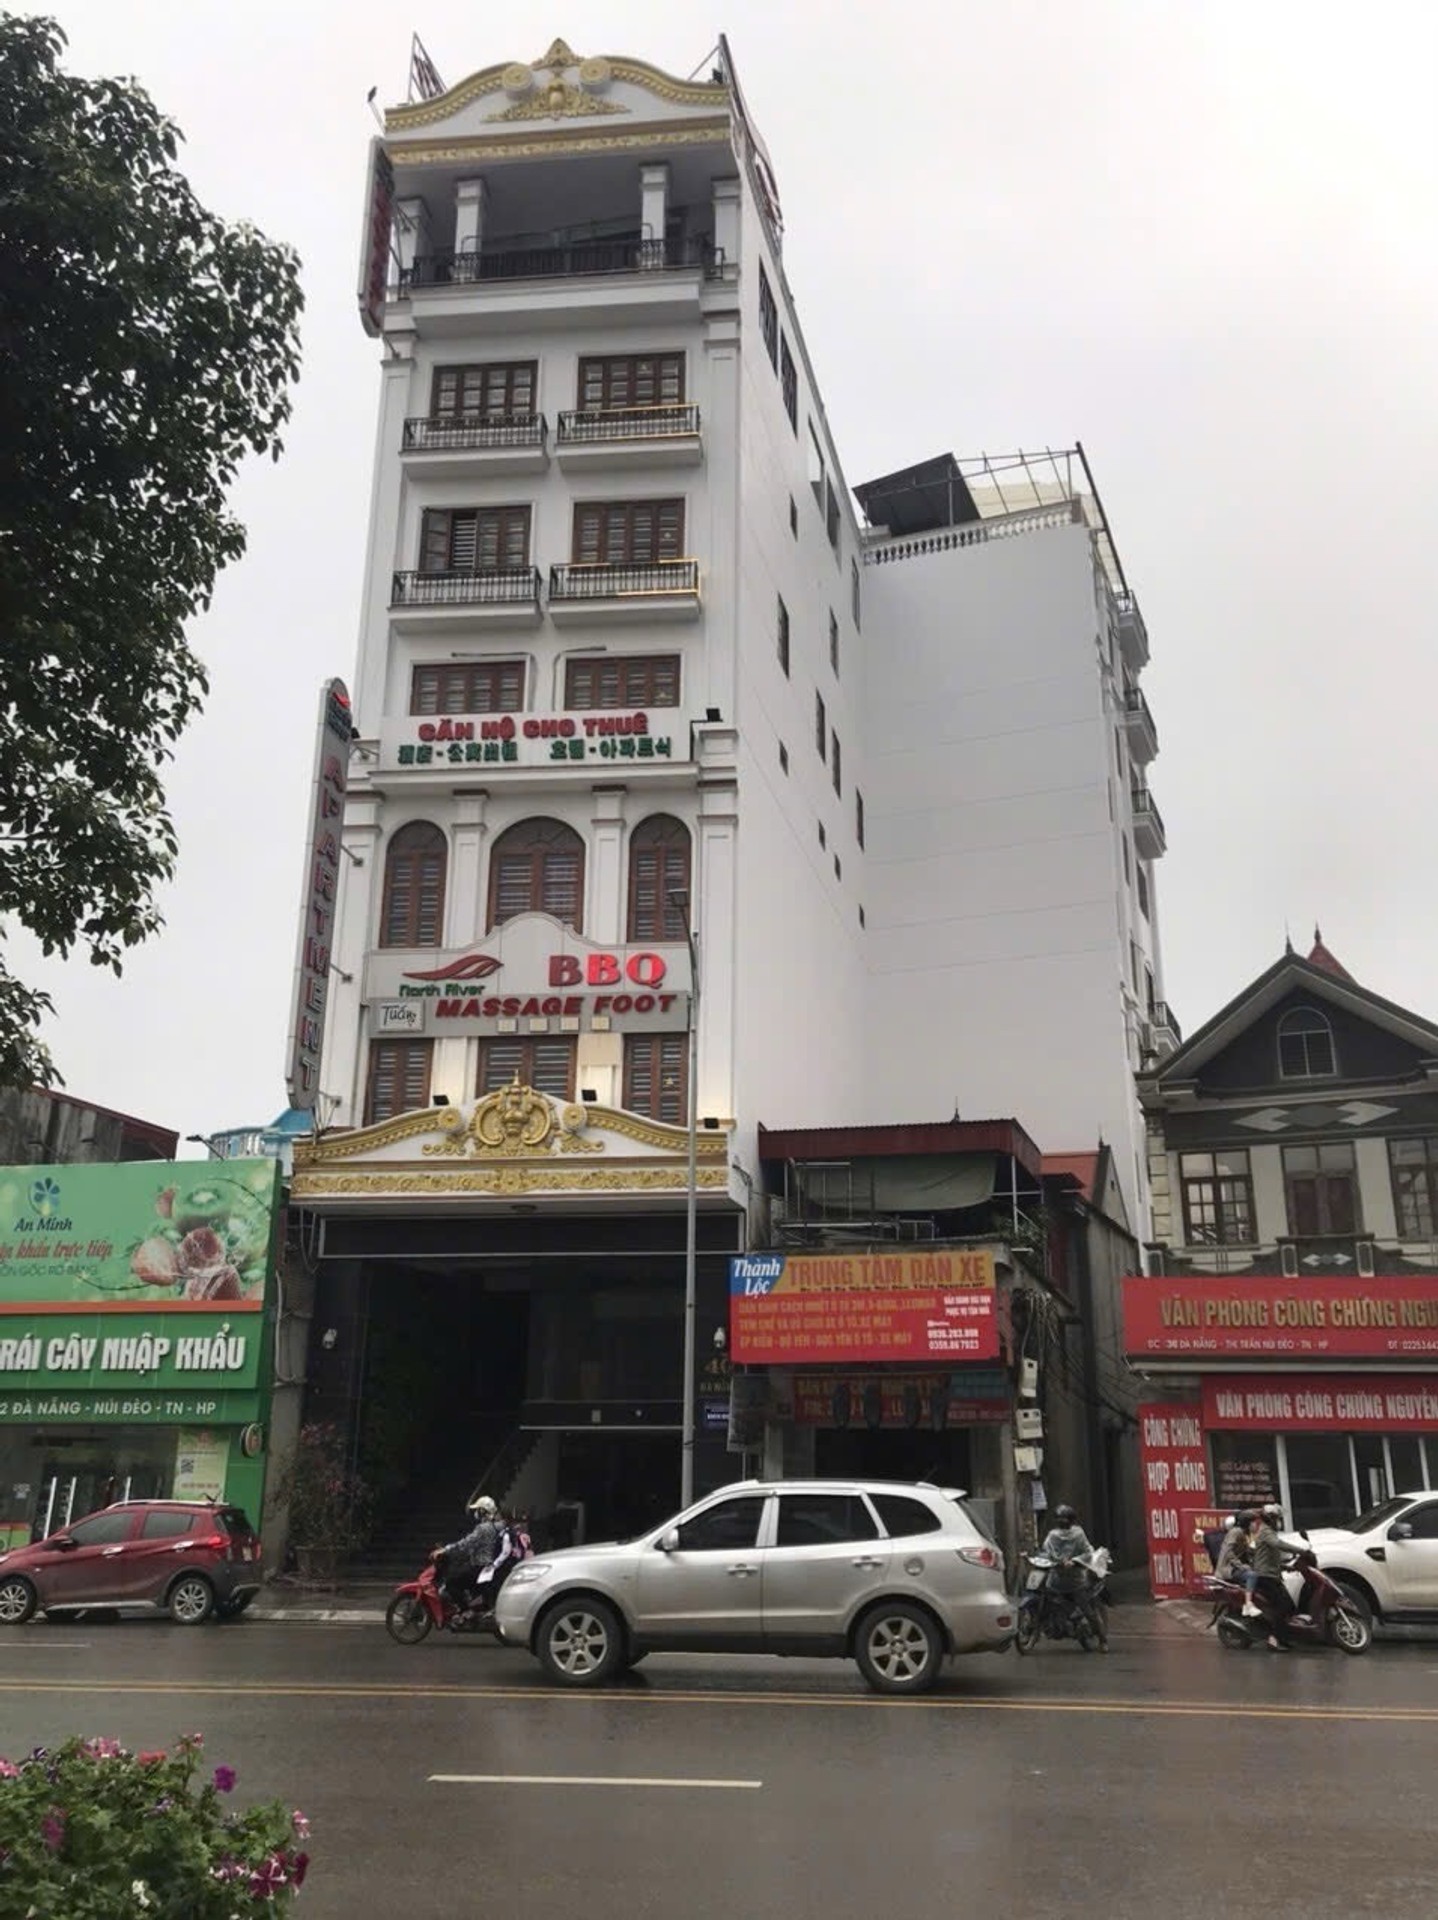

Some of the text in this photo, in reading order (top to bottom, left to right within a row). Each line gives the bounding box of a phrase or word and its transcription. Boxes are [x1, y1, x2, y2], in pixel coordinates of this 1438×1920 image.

[418, 711, 648, 744] CĂN HỘ CHO THUÊ
[301, 756, 347, 1092] APARTMENT
[549, 952, 667, 989] BBQ
[399, 984, 485, 997] North River
[435, 994, 677, 1018] MASSAGE FOOT
[14, 1218, 34, 1232] An
[734, 1258, 780, 1277] Thành
[789, 1260, 853, 1287] TRUNG
[961, 1256, 985, 1281] XE
[745, 1278, 770, 1299] Lộc
[1161, 1294, 1199, 1326] VĂN
[1205, 1293, 1269, 1327] PHÒNG
[1274, 1295, 1326, 1327] CÔNG
[1330, 1296, 1397, 1327] CHỨNG
[46, 1333, 97, 1371] CÂY
[101, 1333, 171, 1375] NHẬP
[175, 1323, 247, 1371] KHẨU
[12, 1398, 32, 1415] ĐÀ
[93, 1400, 118, 1415] NÚI
[122, 1399, 152, 1415] ĐÈO
[165, 1402, 183, 1414] TN
[196, 1402, 216, 1414] HP
[1216, 1391, 1243, 1418] VĂN
[1247, 1390, 1292, 1418] PHÒNG
[1296, 1391, 1332, 1418] CÔNG
[1337, 1390, 1382, 1418] CHỨNG
[1147, 1456, 1206, 1495] HỢP ĐỒNG
[1151, 1509, 1179, 1539] GIAO
